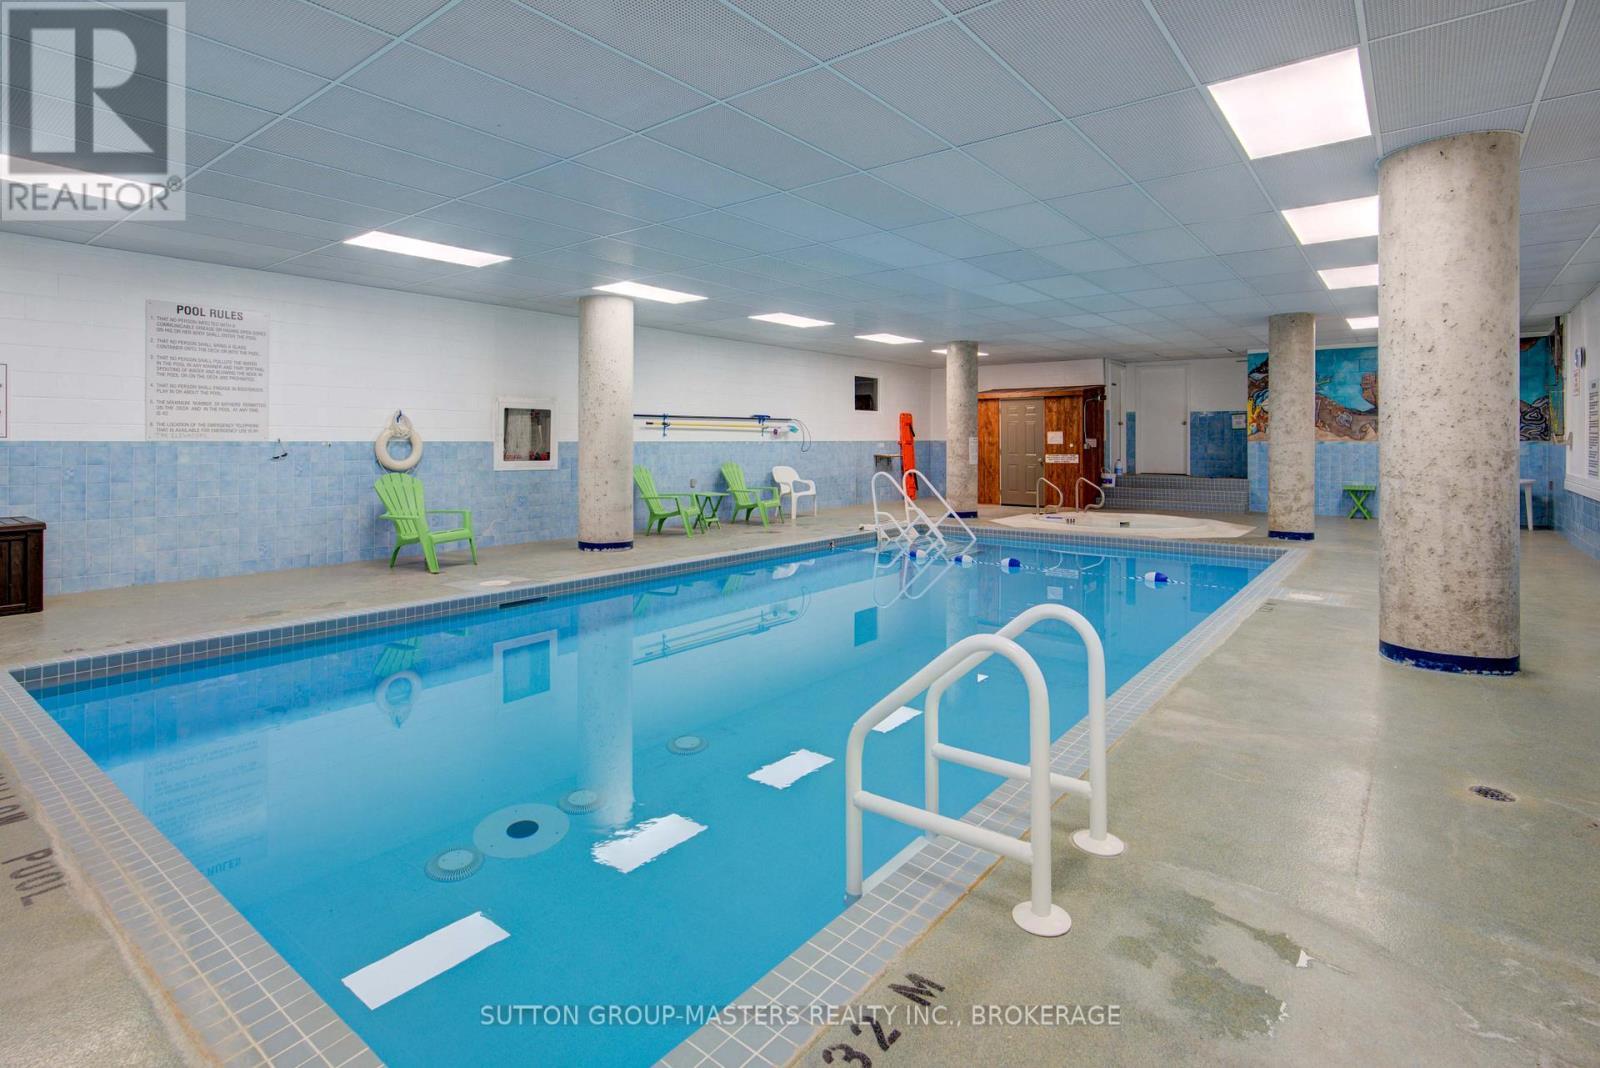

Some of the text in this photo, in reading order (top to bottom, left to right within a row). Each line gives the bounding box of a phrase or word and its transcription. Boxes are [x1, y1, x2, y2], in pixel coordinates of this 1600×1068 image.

[176, 304, 244, 321] POOL RULES
[1, 847, 68, 907] POOL
